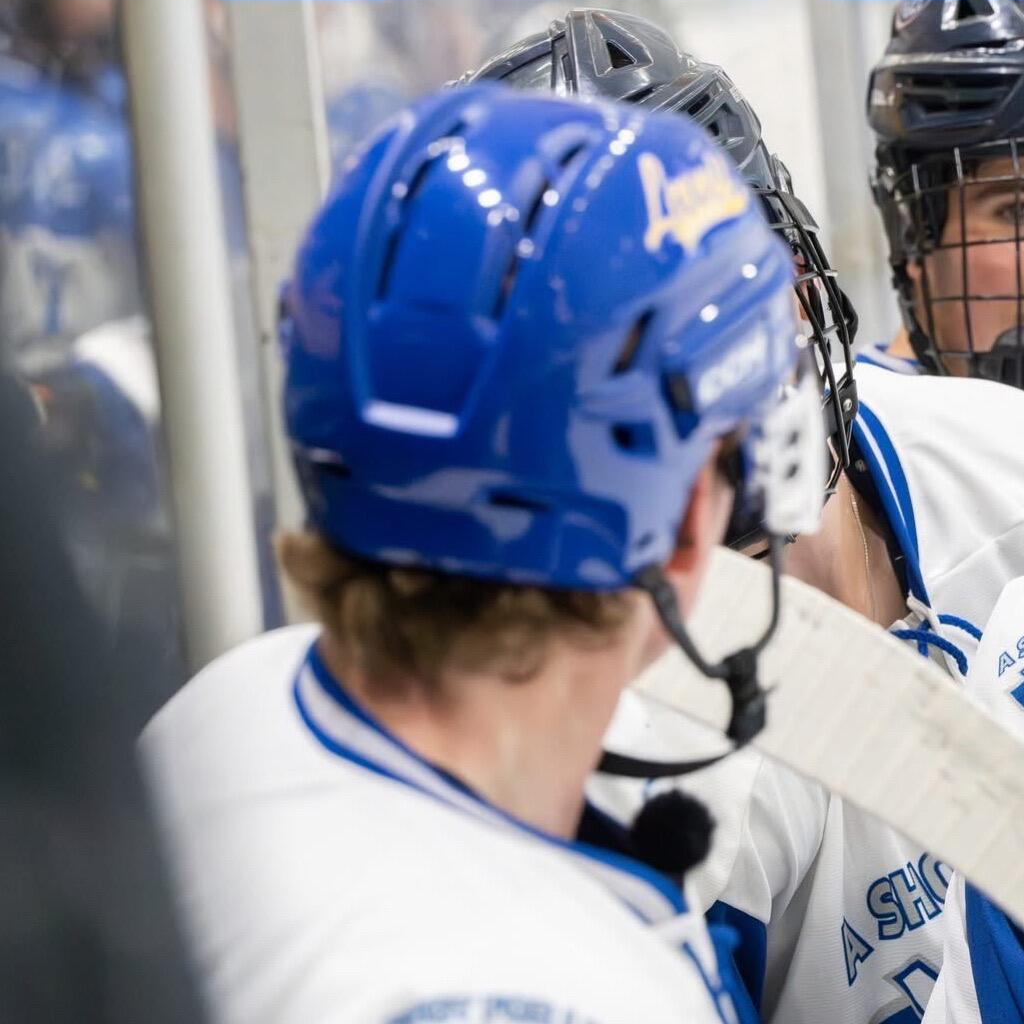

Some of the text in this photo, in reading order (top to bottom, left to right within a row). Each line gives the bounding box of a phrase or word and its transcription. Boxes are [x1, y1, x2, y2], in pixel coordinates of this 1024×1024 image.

[999, 651, 1016, 677] A
[841, 851, 954, 987] A SHO
